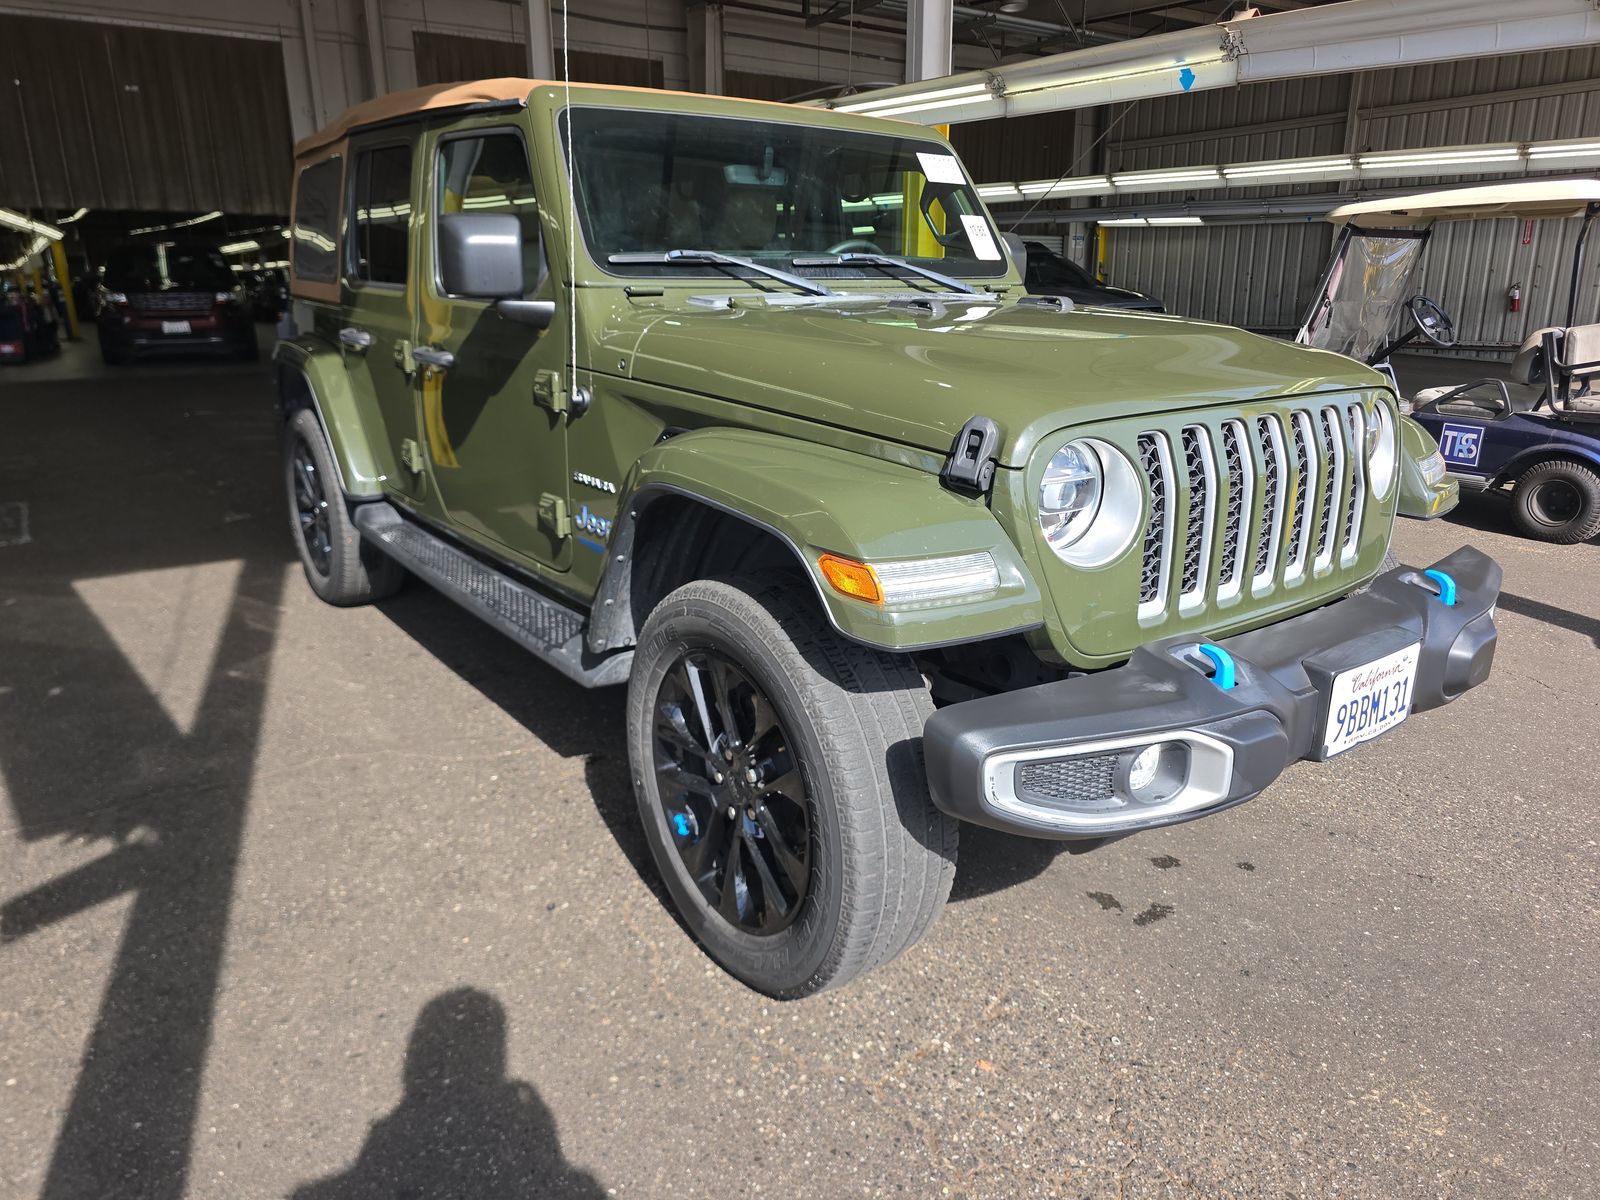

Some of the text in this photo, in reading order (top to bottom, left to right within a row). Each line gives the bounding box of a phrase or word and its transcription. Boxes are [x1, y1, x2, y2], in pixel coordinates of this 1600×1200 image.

[1444, 430, 1478, 459] TRS
[1352, 664, 1404, 693] California
[1333, 676, 1409, 742] 9BBM131
